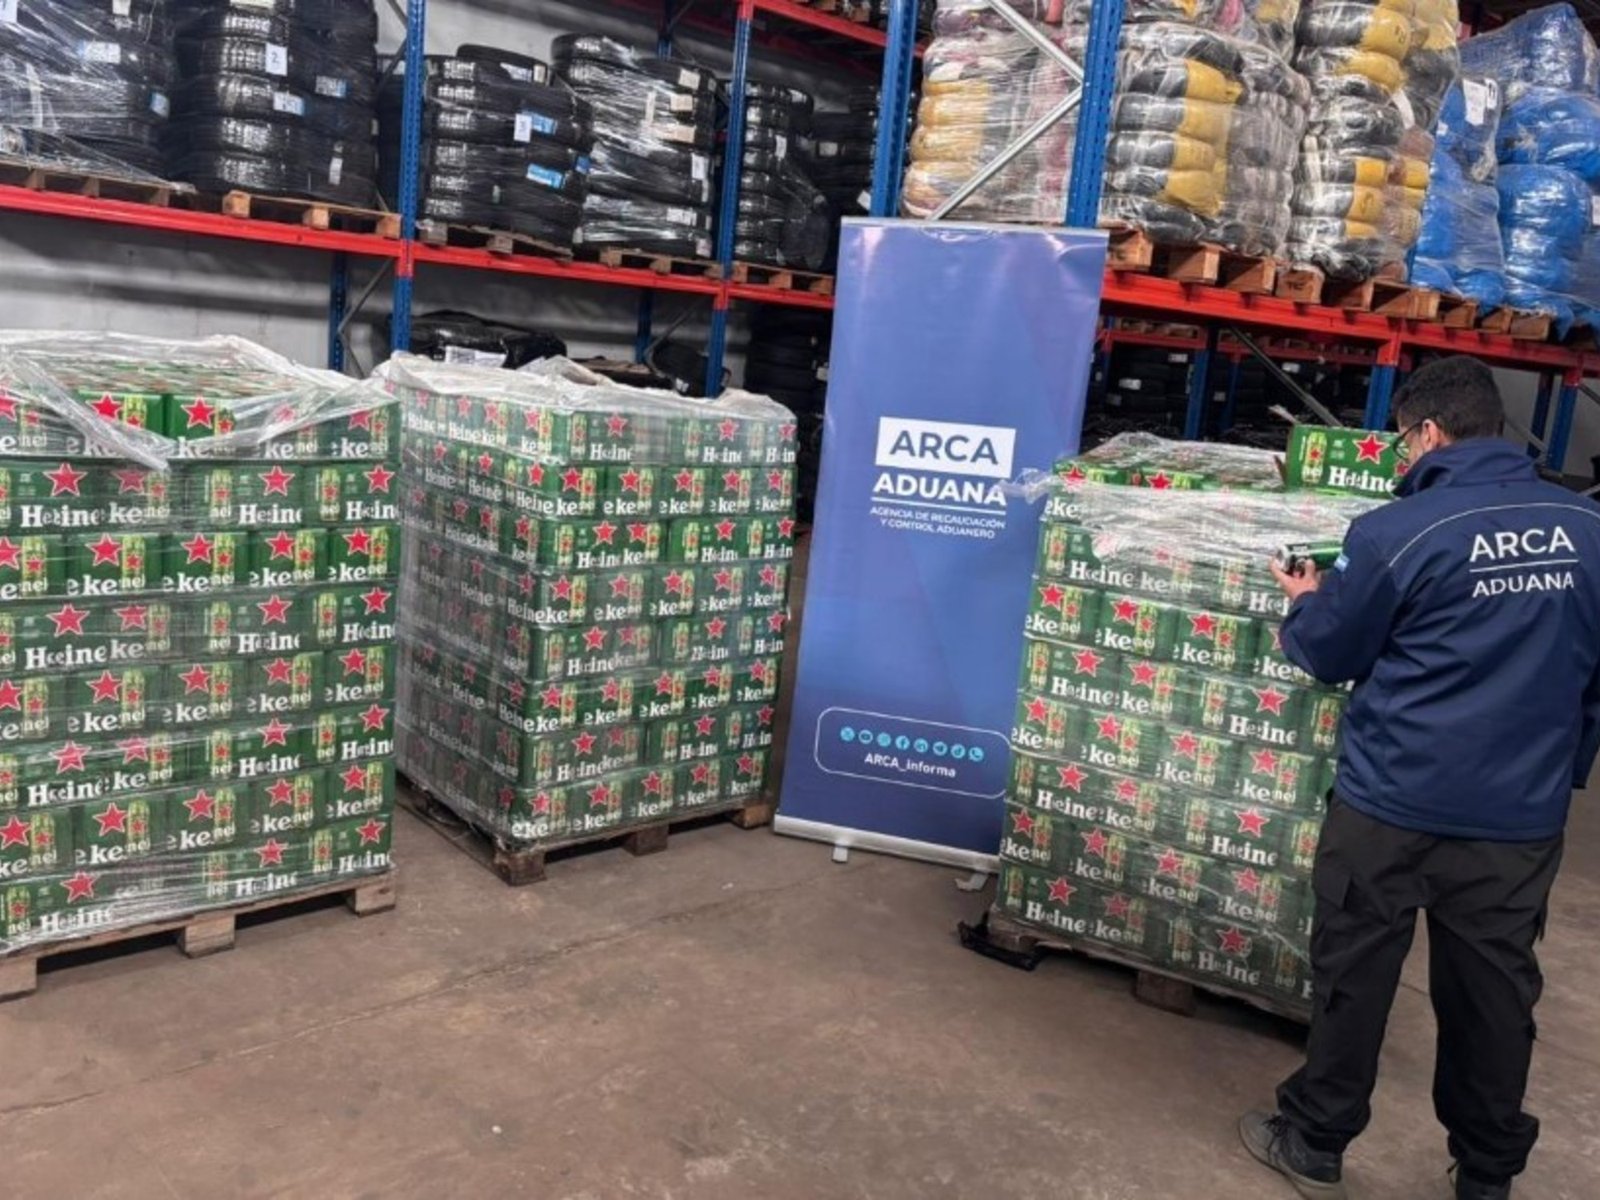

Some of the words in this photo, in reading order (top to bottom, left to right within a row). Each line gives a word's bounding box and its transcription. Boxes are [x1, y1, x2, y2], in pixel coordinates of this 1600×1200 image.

[889, 430, 999, 466] ARCA
[873, 472, 1007, 506] ADUANA
[870, 506, 914, 519] AGENCIA
[915, 509, 930, 521] DE
[888, 520, 934, 533] CONTROL
[936, 525, 995, 539] ADUANERO
[1469, 526, 1575, 563] ARCA
[1472, 572, 1574, 598] ADUANA
[864, 752, 956, 777] ARCA_informa
